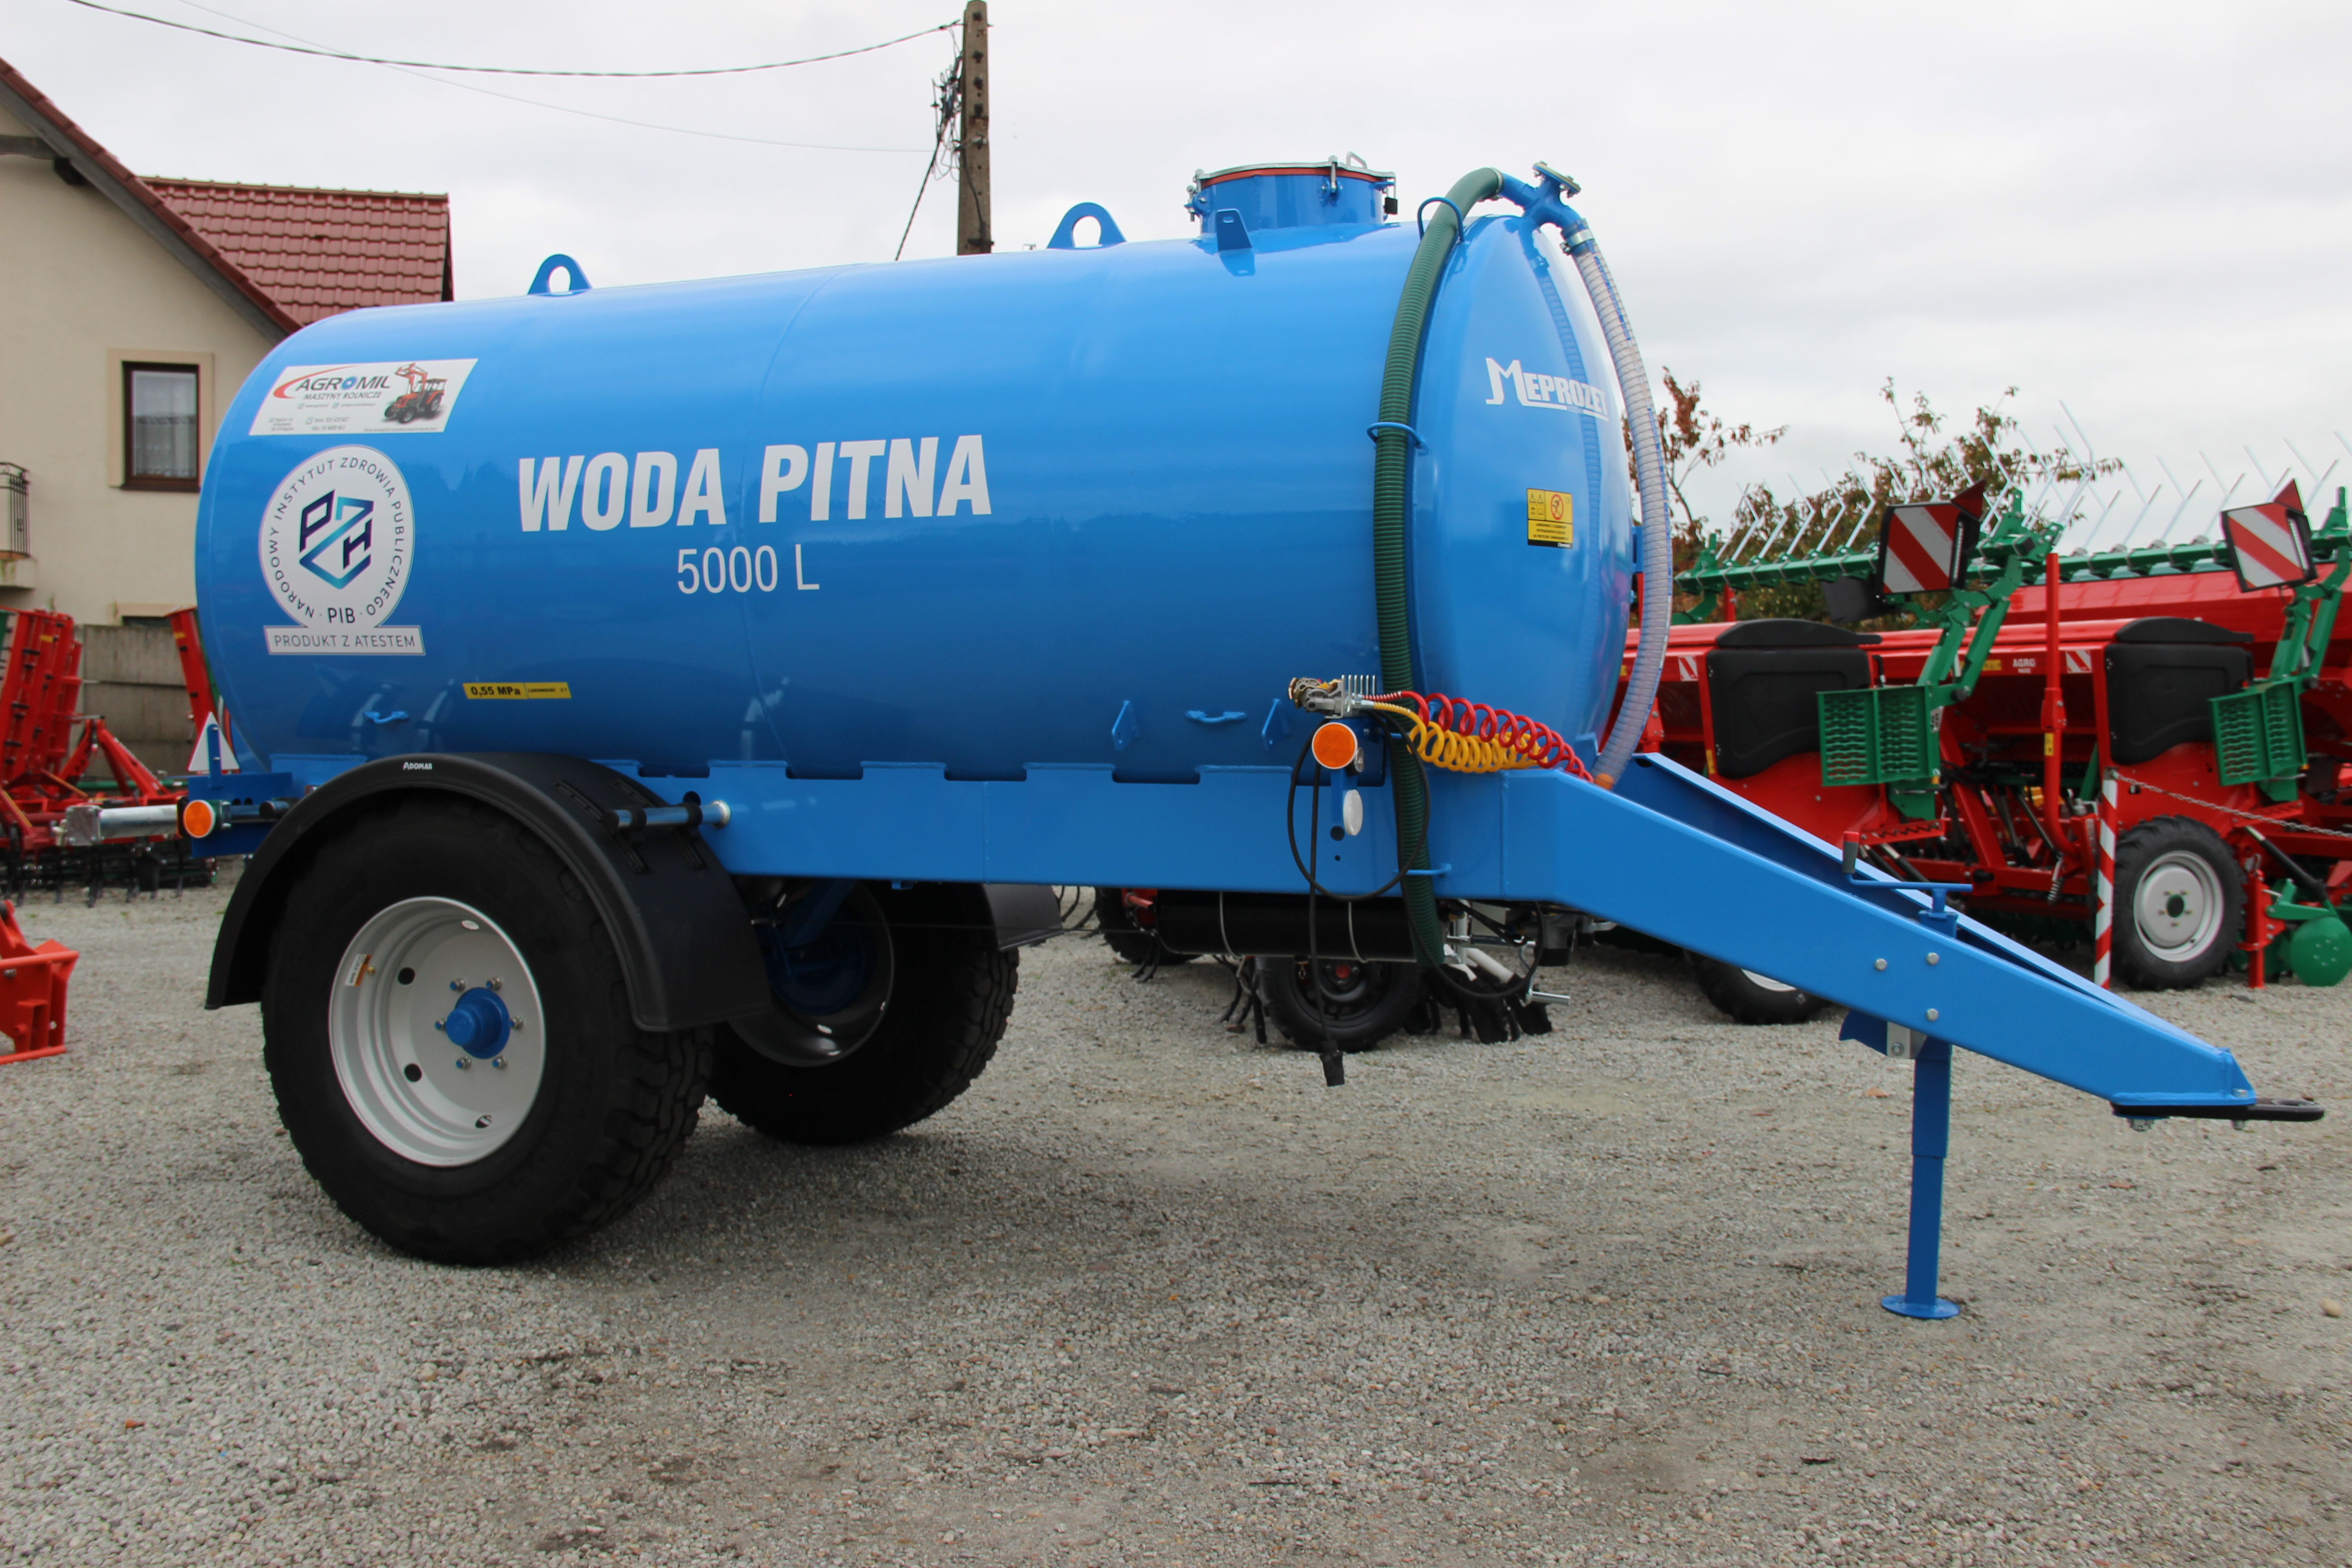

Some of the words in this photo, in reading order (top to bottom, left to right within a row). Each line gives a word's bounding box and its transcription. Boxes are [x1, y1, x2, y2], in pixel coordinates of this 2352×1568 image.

[343, 391, 382, 399] ROLNICZE
[1485, 358, 1608, 421] MEPROZET
[274, 460, 335, 520] INSTYTUT
[340, 457, 396, 498] ZDROWIA
[519, 448, 727, 532] WODA
[759, 434, 992, 524] PITNA
[270, 528, 315, 618] NARODOWY
[366, 501, 405, 616] PUBLICZNEGO
[677, 546, 778, 594] 5000
[795, 544, 820, 591] L
[328, 607, 356, 624] PIB
[274, 635, 337, 647] PRODUKT
[342, 635, 351, 647] Z
[355, 635, 416, 648] ATESTEM
[2013, 658, 2036, 667] AGRO
[470, 686, 495, 696] 0,55
[497, 686, 521, 696] MPa
